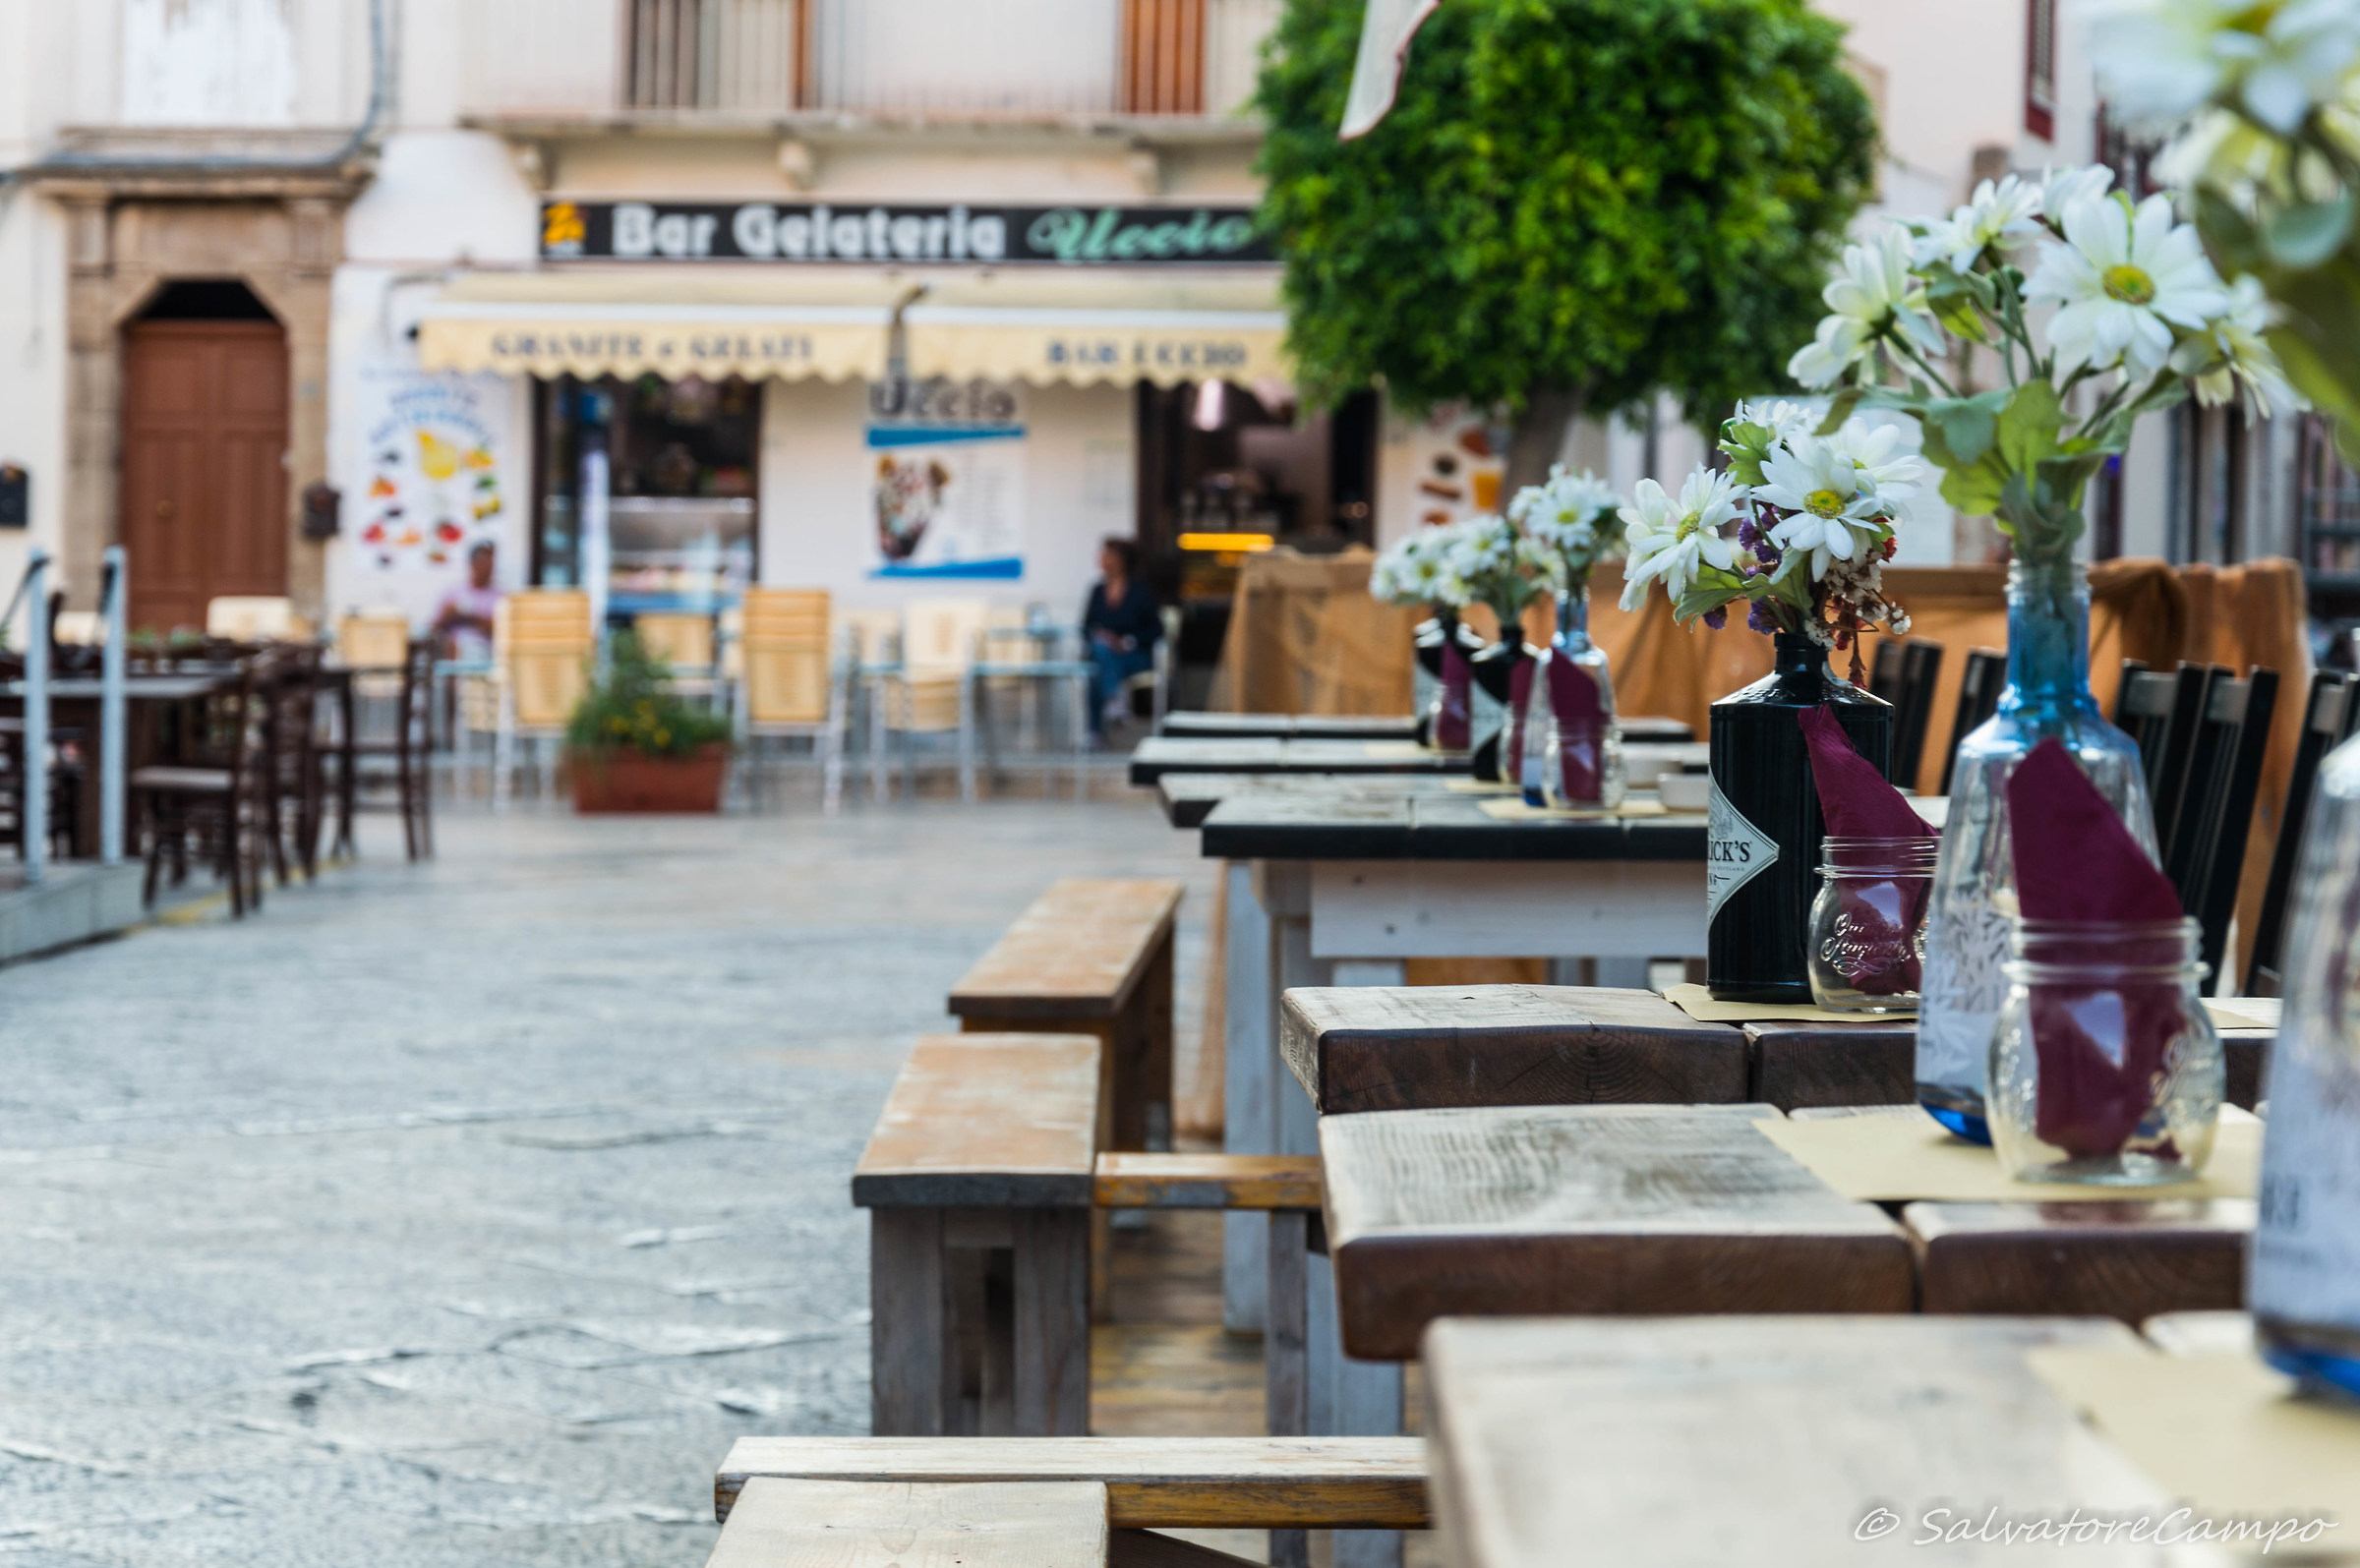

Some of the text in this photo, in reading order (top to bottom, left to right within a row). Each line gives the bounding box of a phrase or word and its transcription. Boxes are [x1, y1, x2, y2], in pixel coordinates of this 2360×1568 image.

[613, 203, 1255, 263] Bar Gelateria Uccio
[1046, 338, 1246, 367] BAR UCCIO
